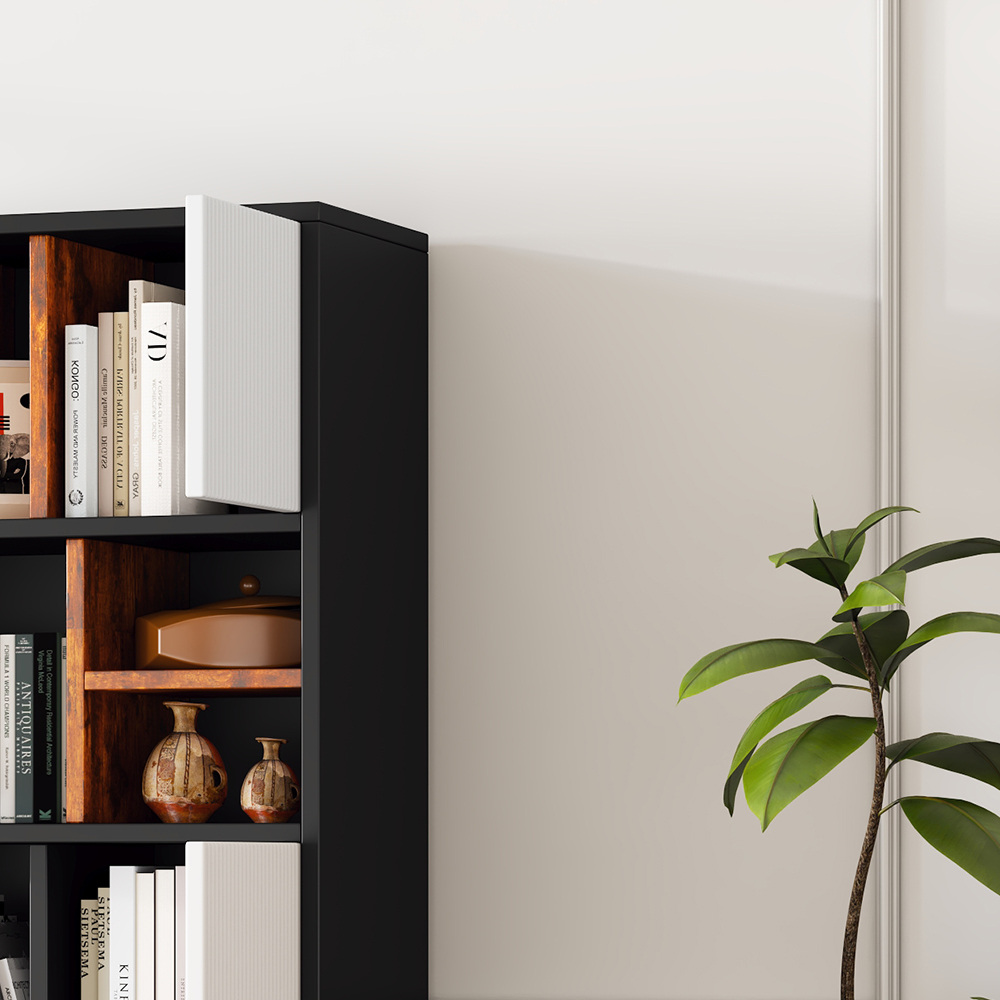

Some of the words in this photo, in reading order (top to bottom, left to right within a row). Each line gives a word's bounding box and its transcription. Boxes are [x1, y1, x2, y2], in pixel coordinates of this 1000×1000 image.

[45, 673, 53, 711] Contemporary
[19, 682, 31, 775] ANTIQUAIRES
[81, 908, 89, 979] SIETSEMA
